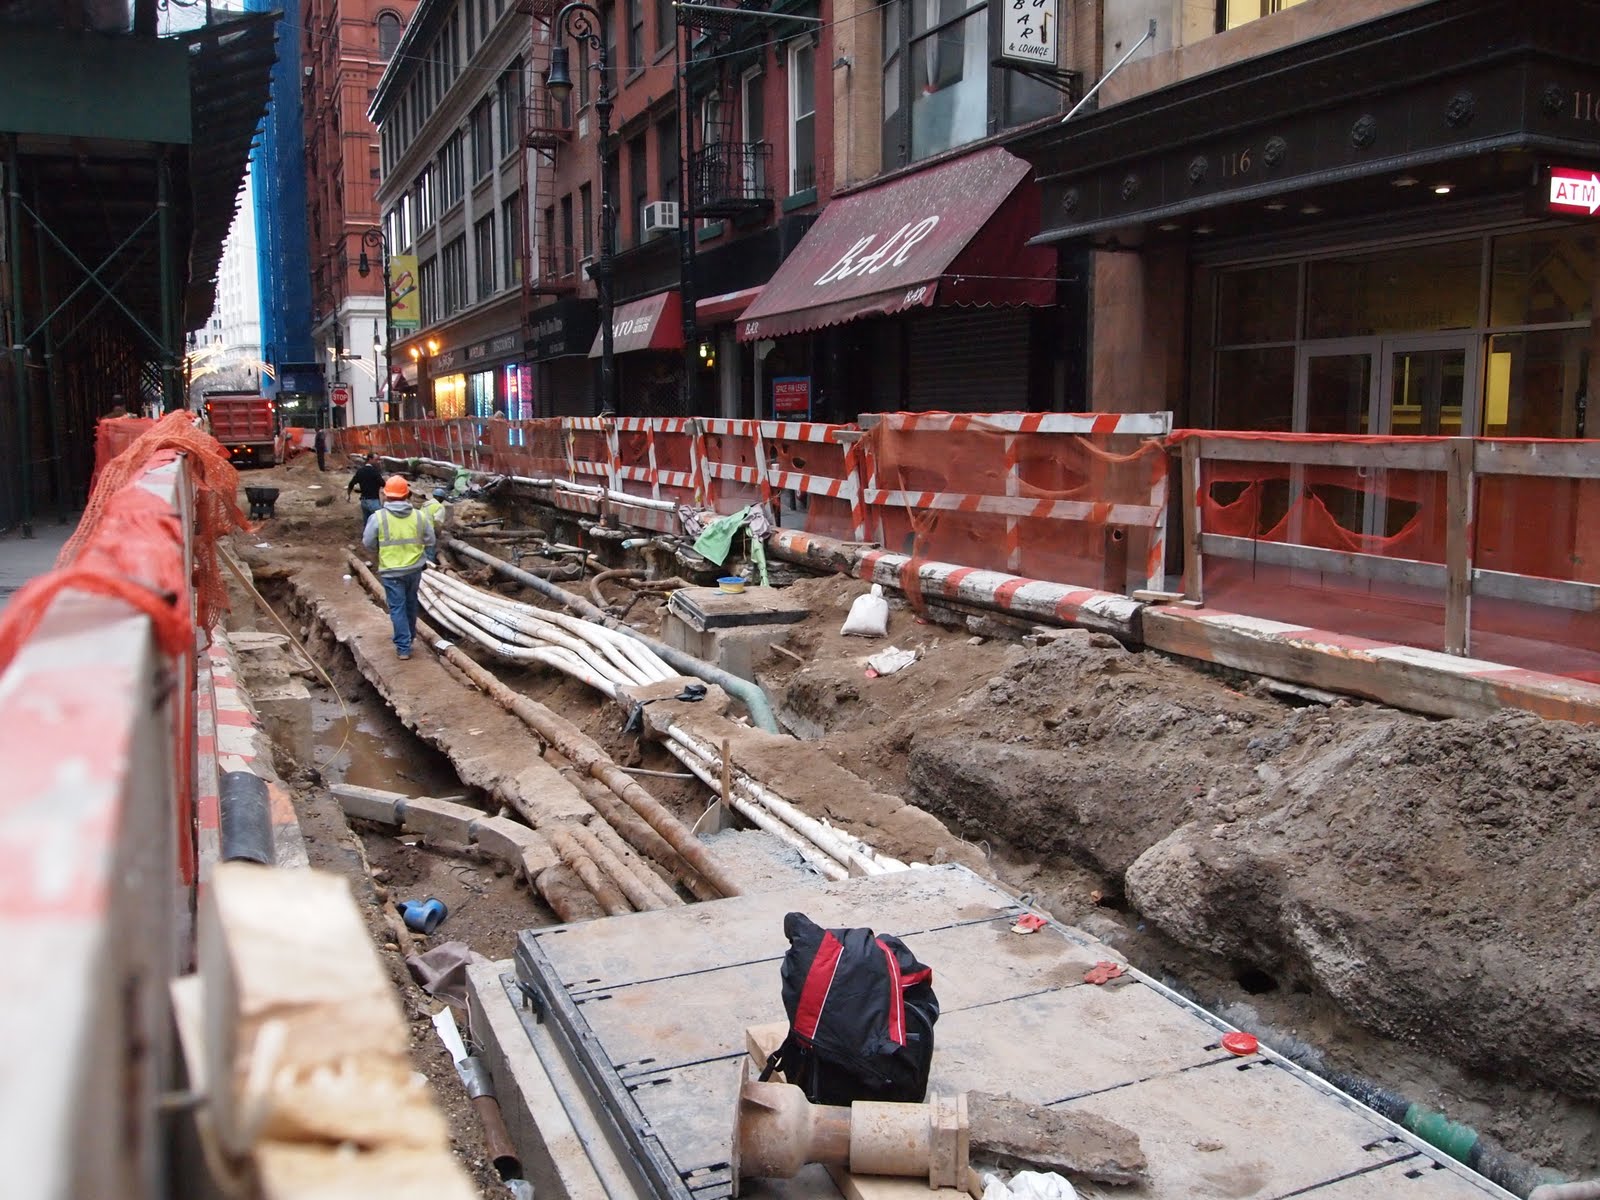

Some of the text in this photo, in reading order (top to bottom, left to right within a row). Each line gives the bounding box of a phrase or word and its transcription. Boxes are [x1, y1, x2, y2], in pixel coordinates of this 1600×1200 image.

[1008, 43, 1049, 56] & LOUNGE
[1221, 148, 1251, 177] 116
[1556, 182, 1596, 202] ATM
[814, 215, 940, 286] BAR
[903, 286, 927, 304] BAR
[745, 322, 760, 335] BAR
